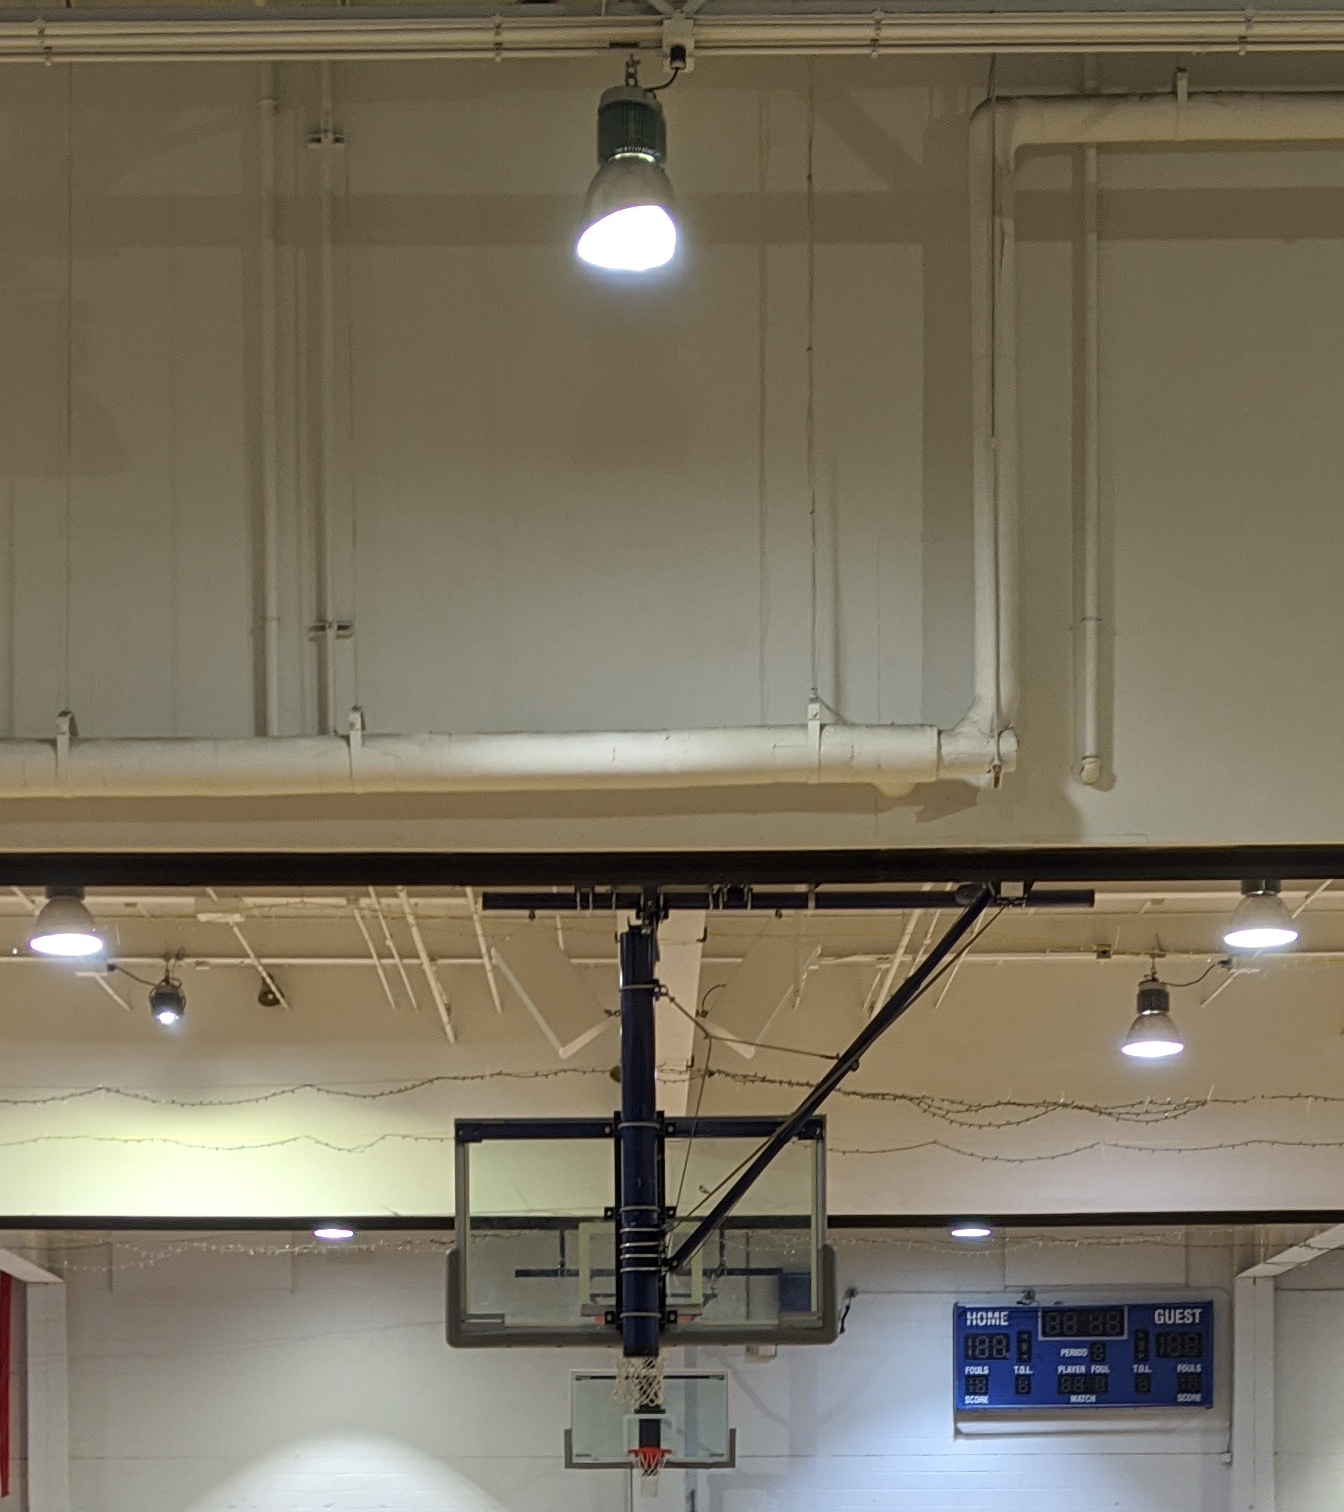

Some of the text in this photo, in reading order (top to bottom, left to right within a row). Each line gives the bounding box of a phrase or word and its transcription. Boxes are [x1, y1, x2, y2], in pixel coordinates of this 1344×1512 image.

[966, 1311, 1009, 1326] HOME
[1155, 1309, 1202, 1324] GUEST
[1060, 1349, 1088, 1357] PERIOD
[964, 1366, 989, 1375] FOULS
[1057, 1365, 1111, 1374] PLAYER FOUL
[1177, 1364, 1202, 1373] FOULS
[964, 1395, 989, 1404] SCORE
[1070, 1395, 1096, 1403] MATCH
